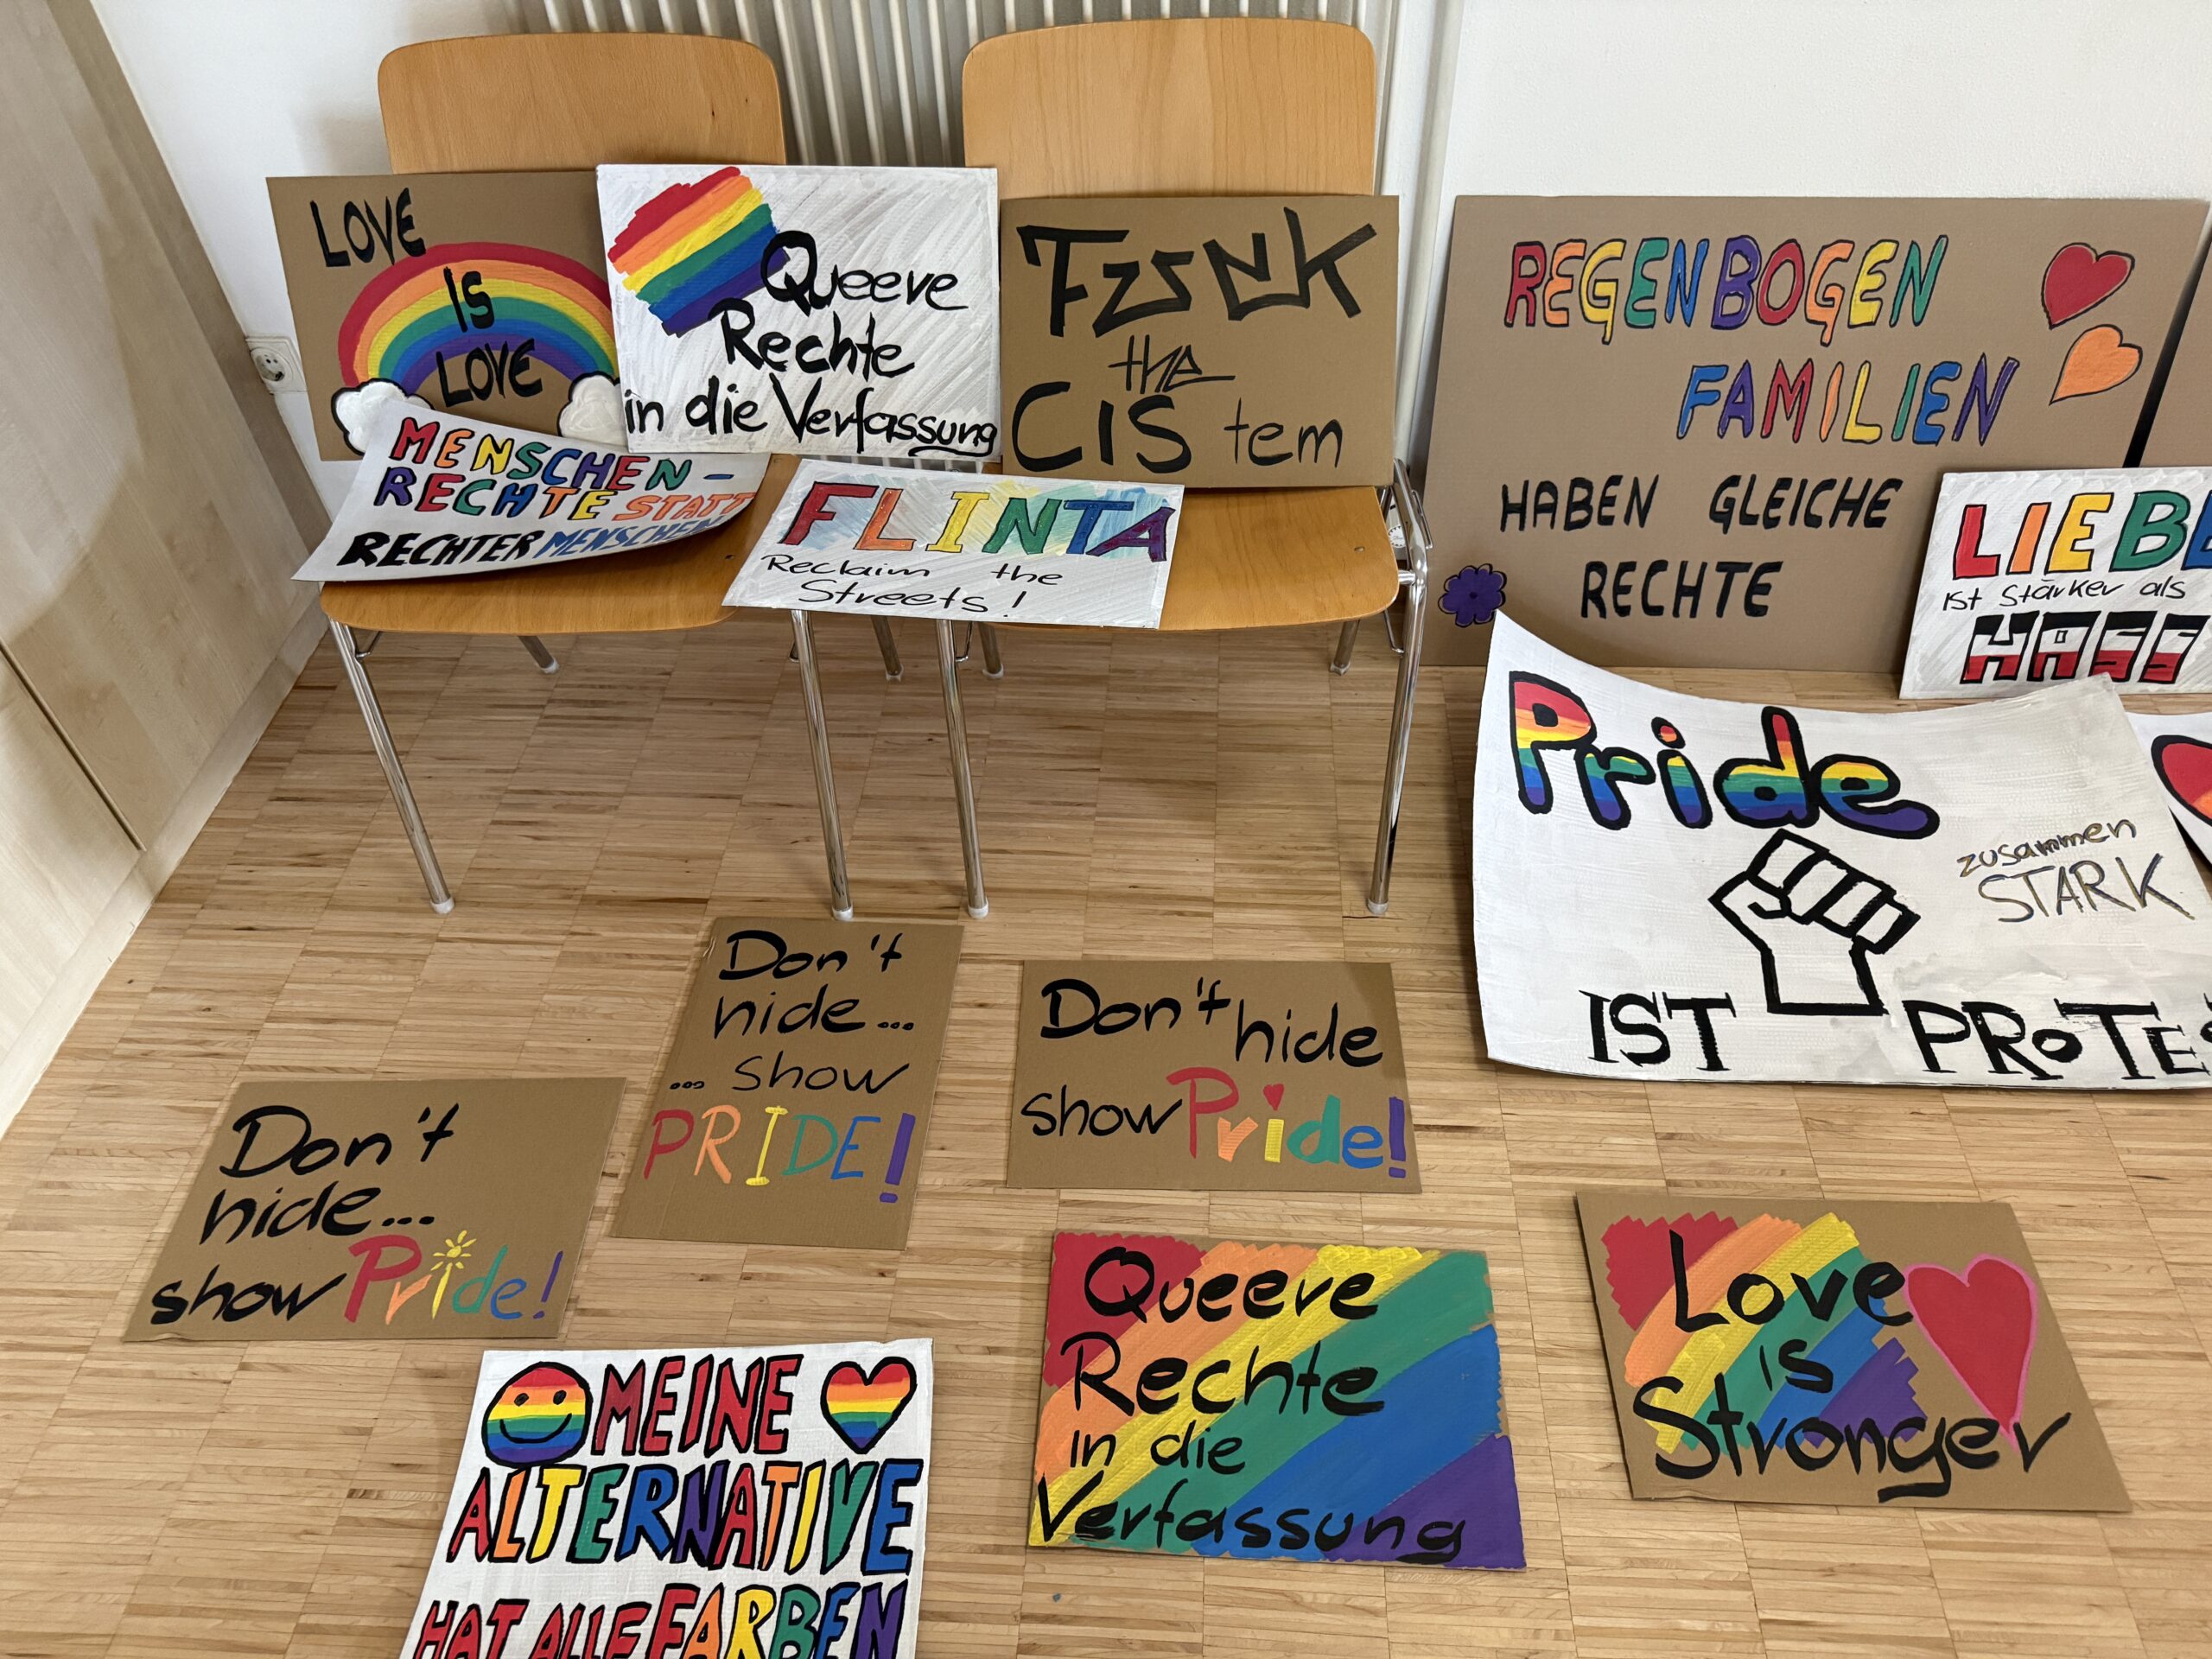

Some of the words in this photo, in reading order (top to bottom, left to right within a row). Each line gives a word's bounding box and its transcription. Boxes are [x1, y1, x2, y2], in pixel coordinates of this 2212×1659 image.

[309, 188, 427, 269] LOVE
[443, 266, 495, 333] IS
[436, 338, 543, 408] LOVE
[708, 297, 915, 382] Rechte
[1108, 334, 1236, 395] the
[624, 389, 664, 434] in
[685, 375, 767, 435] die
[769, 373, 999, 457] Verfassung
[1011, 381, 1192, 474] CIS
[1224, 397, 1344, 468] tem
[1675, 353, 2020, 446] FAMILIEN
[374, 466, 619, 521] RECHTE
[612, 492, 757, 522] STATT
[778, 480, 1177, 563] FLINTA
[1500, 474, 1660, 532] HABEN
[1708, 477, 1903, 535] GLEICHE
[336, 530, 547, 568] RECHTER
[760, 554, 931, 577] Reclaim
[991, 563, 1064, 586] the
[1580, 561, 1784, 620] RECHTE
[2139, 575, 2186, 599] als
[1961, 610, 2212, 685] HASS
[1509, 671, 1941, 840] Pride
[1957, 819, 2137, 878] zusammen
[1977, 853, 2196, 923] STARK
[1234, 1009, 1384, 1068] hide
[1579, 988, 1738, 1071] IST
[1901, 992, 2212, 1082] PROTE
[732, 1052, 910, 1096] show
[1020, 1085, 1184, 1138] show
[150, 1264, 347, 1325] show
[1668, 1229, 1914, 1333] Love
[590, 1353, 804, 1457] MEINE
[1060, 1331, 1385, 1417] Rechte
[1151, 1420, 1245, 1475] die
[1632, 1373, 2072, 1503] Stronger
[446, 1459, 925, 1575] ALTERNATIVE
[1037, 1471, 1466, 1565] Verfassung
[415, 1599, 530, 1659] HAT
[524, 1600, 652, 1659] ALLE
[646, 1579, 909, 1659] FARBEN
